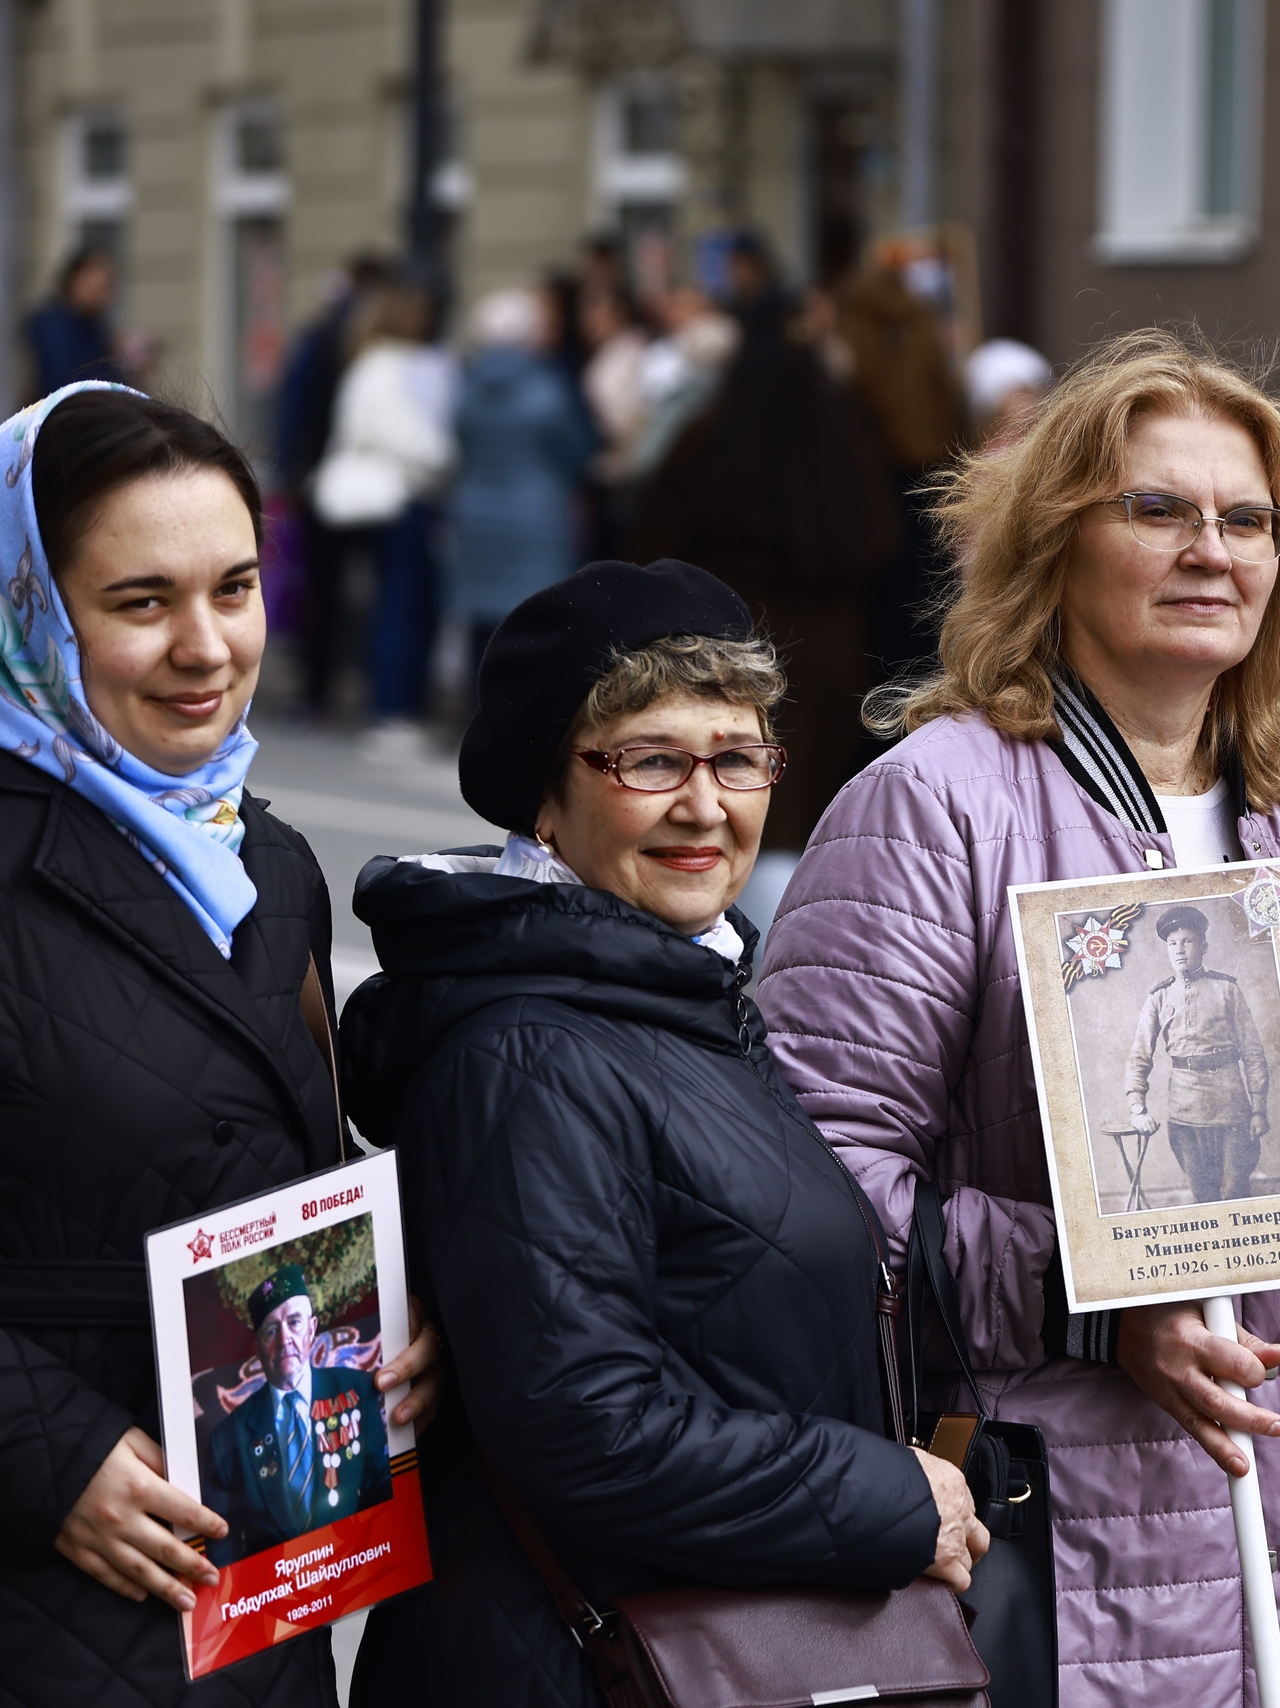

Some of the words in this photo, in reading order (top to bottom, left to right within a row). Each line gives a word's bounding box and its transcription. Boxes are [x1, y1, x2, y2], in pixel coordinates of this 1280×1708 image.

[301, 1200, 318, 1221] 80
[319, 1185, 364, 1213] ПОБЕДА!
[219, 1212, 277, 1243] БЕССМЕРТНЫЙ
[221, 1239, 242, 1255] ПОЛК
[244, 1227, 275, 1248] РОССИИ
[1111, 1218, 1220, 1241] Багаутдинов
[1128, 1259, 1209, 1281] 15.07.1926
[275, 1543, 334, 1579] Яруллин
[221, 1580, 293, 1621] Габдулхак
[296, 1542, 391, 1591] Шайдуллович
[287, 1595, 334, 1622] 1926-2011
